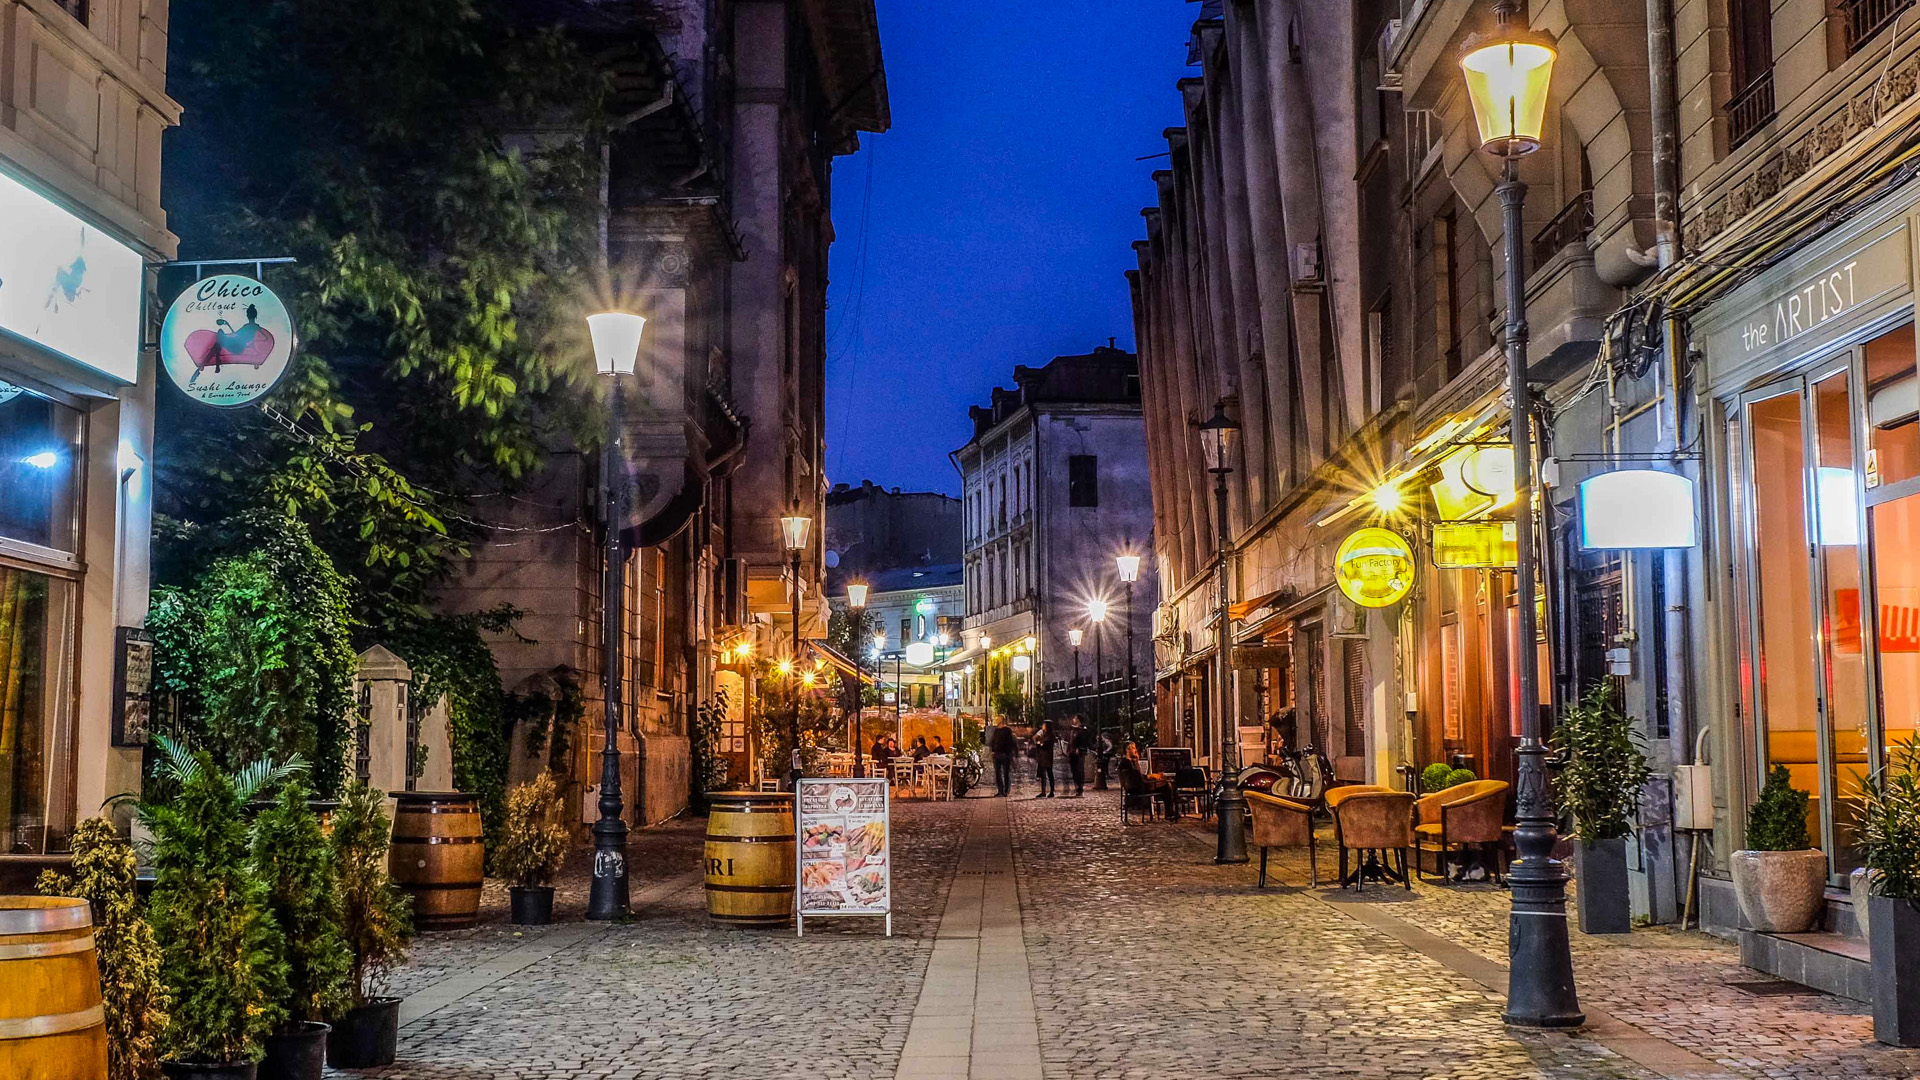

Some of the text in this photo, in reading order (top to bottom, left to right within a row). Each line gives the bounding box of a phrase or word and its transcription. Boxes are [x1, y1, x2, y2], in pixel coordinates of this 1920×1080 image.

[197, 280, 263, 301] Chico
[186, 302, 236, 312] Chillout
[1742, 261, 1857, 351] the ARTIST
[187, 381, 267, 392] Sushi Lounge
[1369, 558, 1400, 568] Factory
